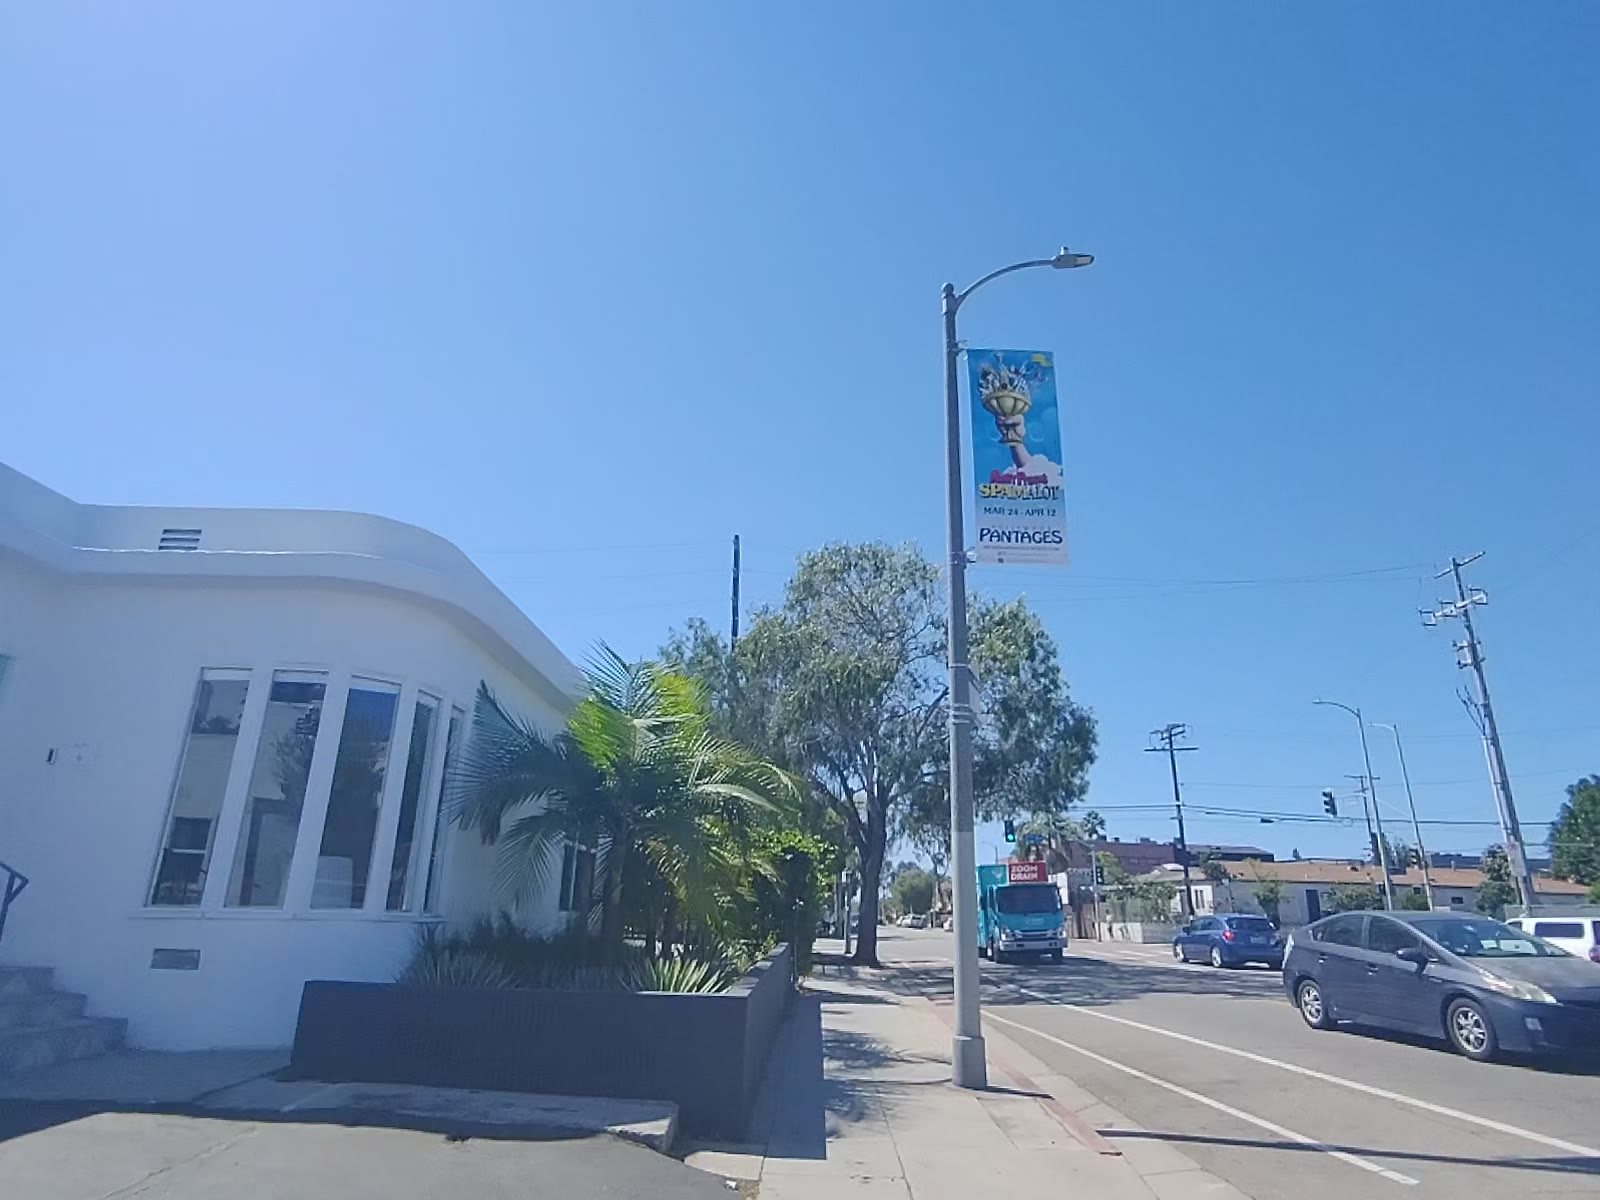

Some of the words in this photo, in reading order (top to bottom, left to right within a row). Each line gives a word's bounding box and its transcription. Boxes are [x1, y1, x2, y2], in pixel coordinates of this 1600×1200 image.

[983, 507, 1005, 516] MAR
[1007, 508, 1018, 516] 24
[1025, 508, 1044, 517] APR
[1046, 508, 1056, 517] 12
[979, 528, 1063, 544] PANTAGES
[1010, 872, 1038, 881] DRAIN
